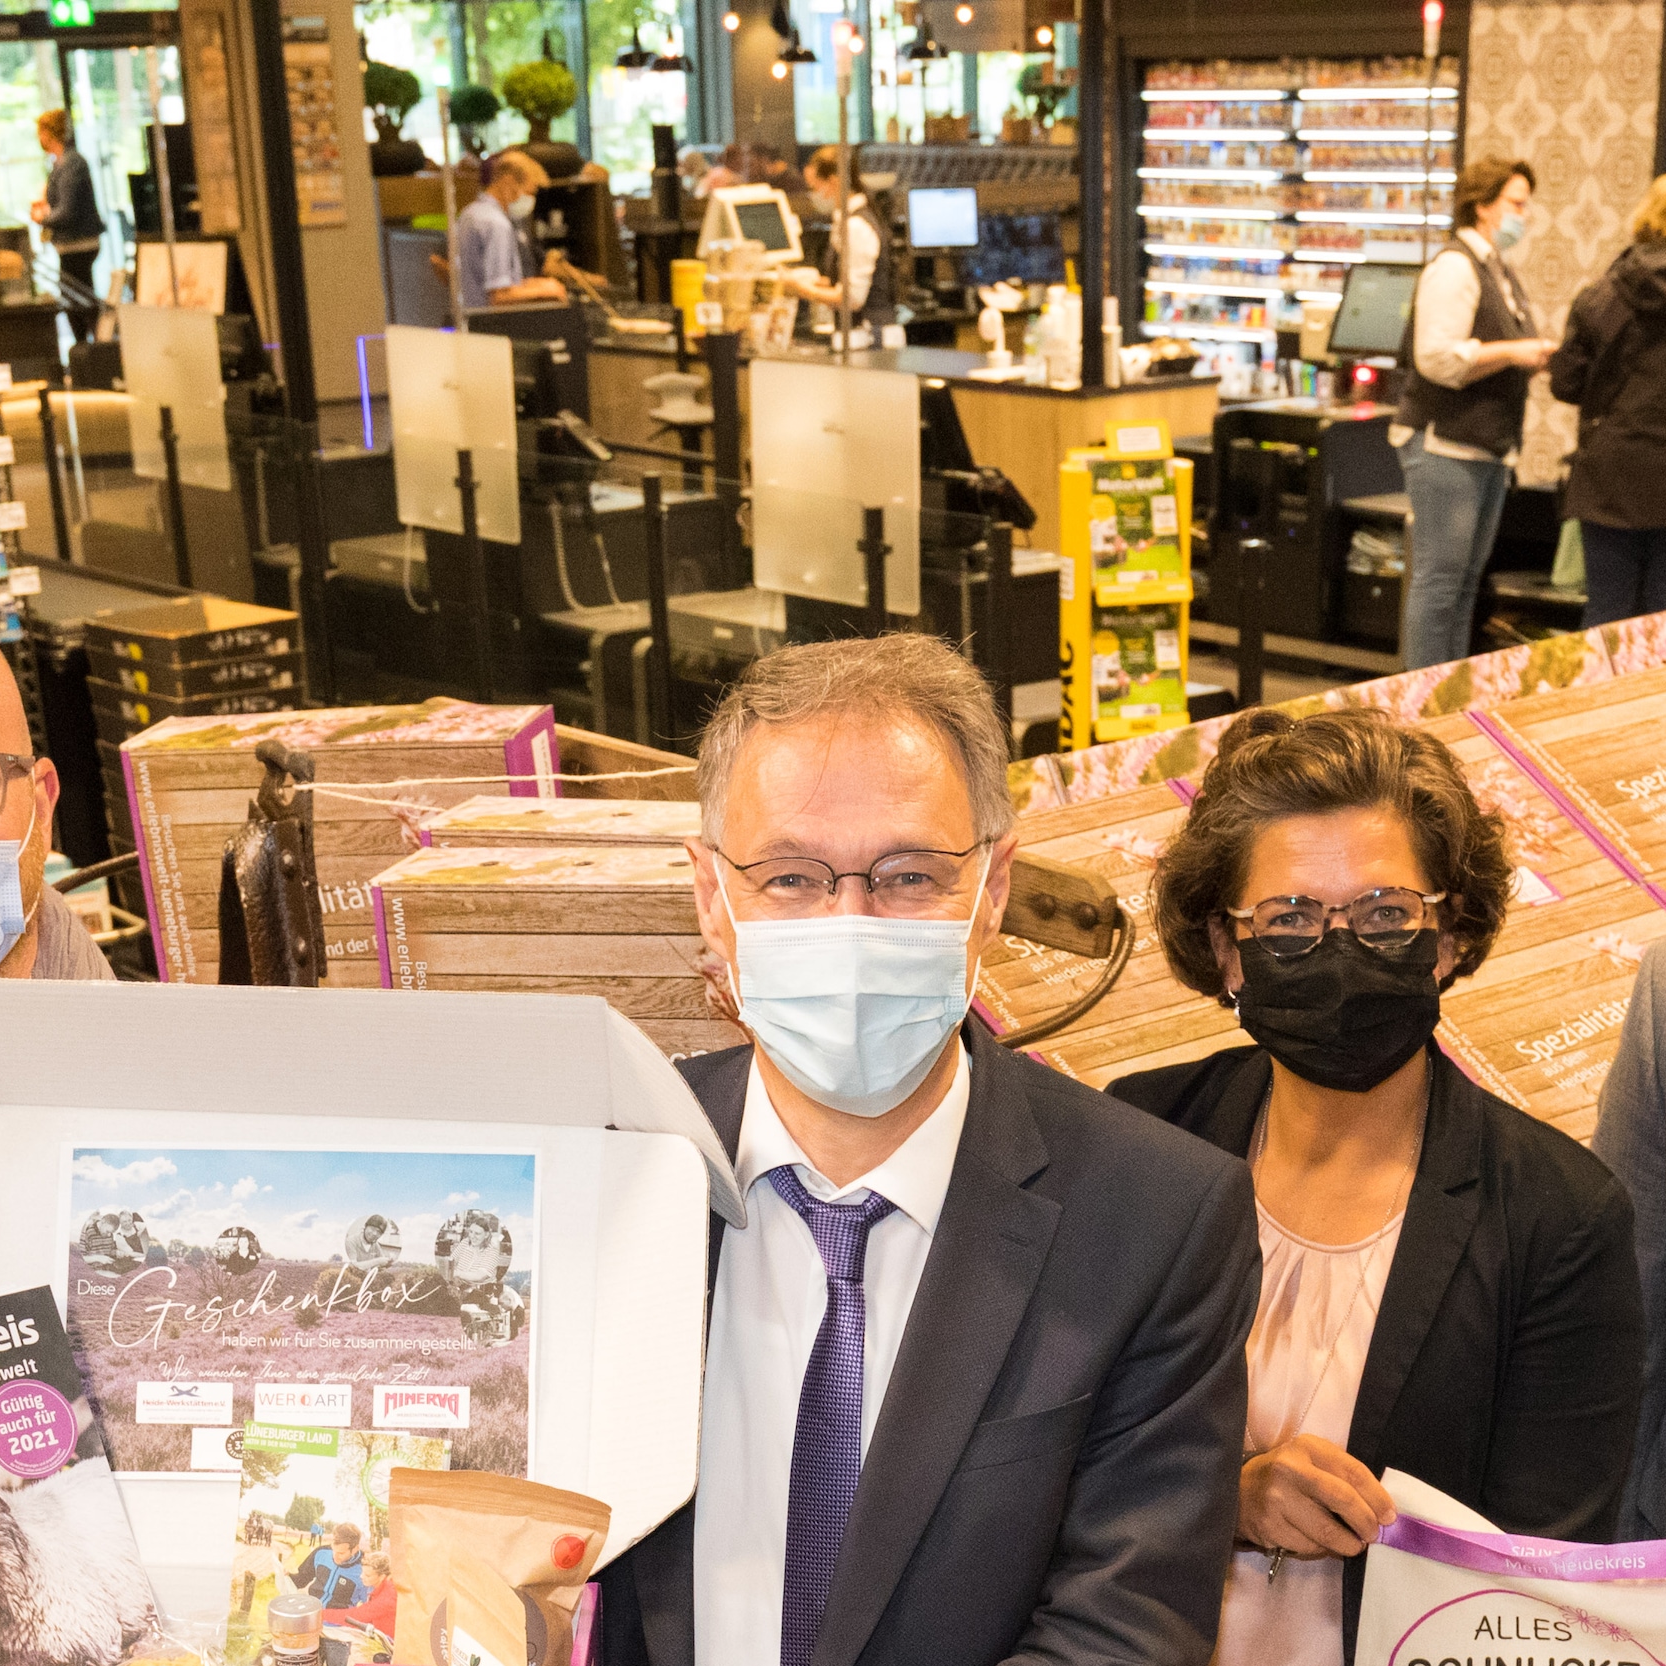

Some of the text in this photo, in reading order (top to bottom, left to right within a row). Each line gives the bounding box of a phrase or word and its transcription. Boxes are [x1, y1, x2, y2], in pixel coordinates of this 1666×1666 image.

[160, 813, 178, 869] Besuchen
[76, 1262, 443, 1350] Diese Geschenkbox
[221, 1331, 477, 1356] haben wir für Sie zusammengestellt.
[0, 1392, 46, 1416] Gültig
[33, 1408, 57, 1426] für
[383, 1391, 460, 1421] MINERVA
[7, 1427, 60, 1456] 2021
[244, 1421, 333, 1446] LÜNEBURGER LAND
[1504, 1553, 1647, 1575] Mein Heidekreis
[1473, 1615, 1573, 1642] ALLES
